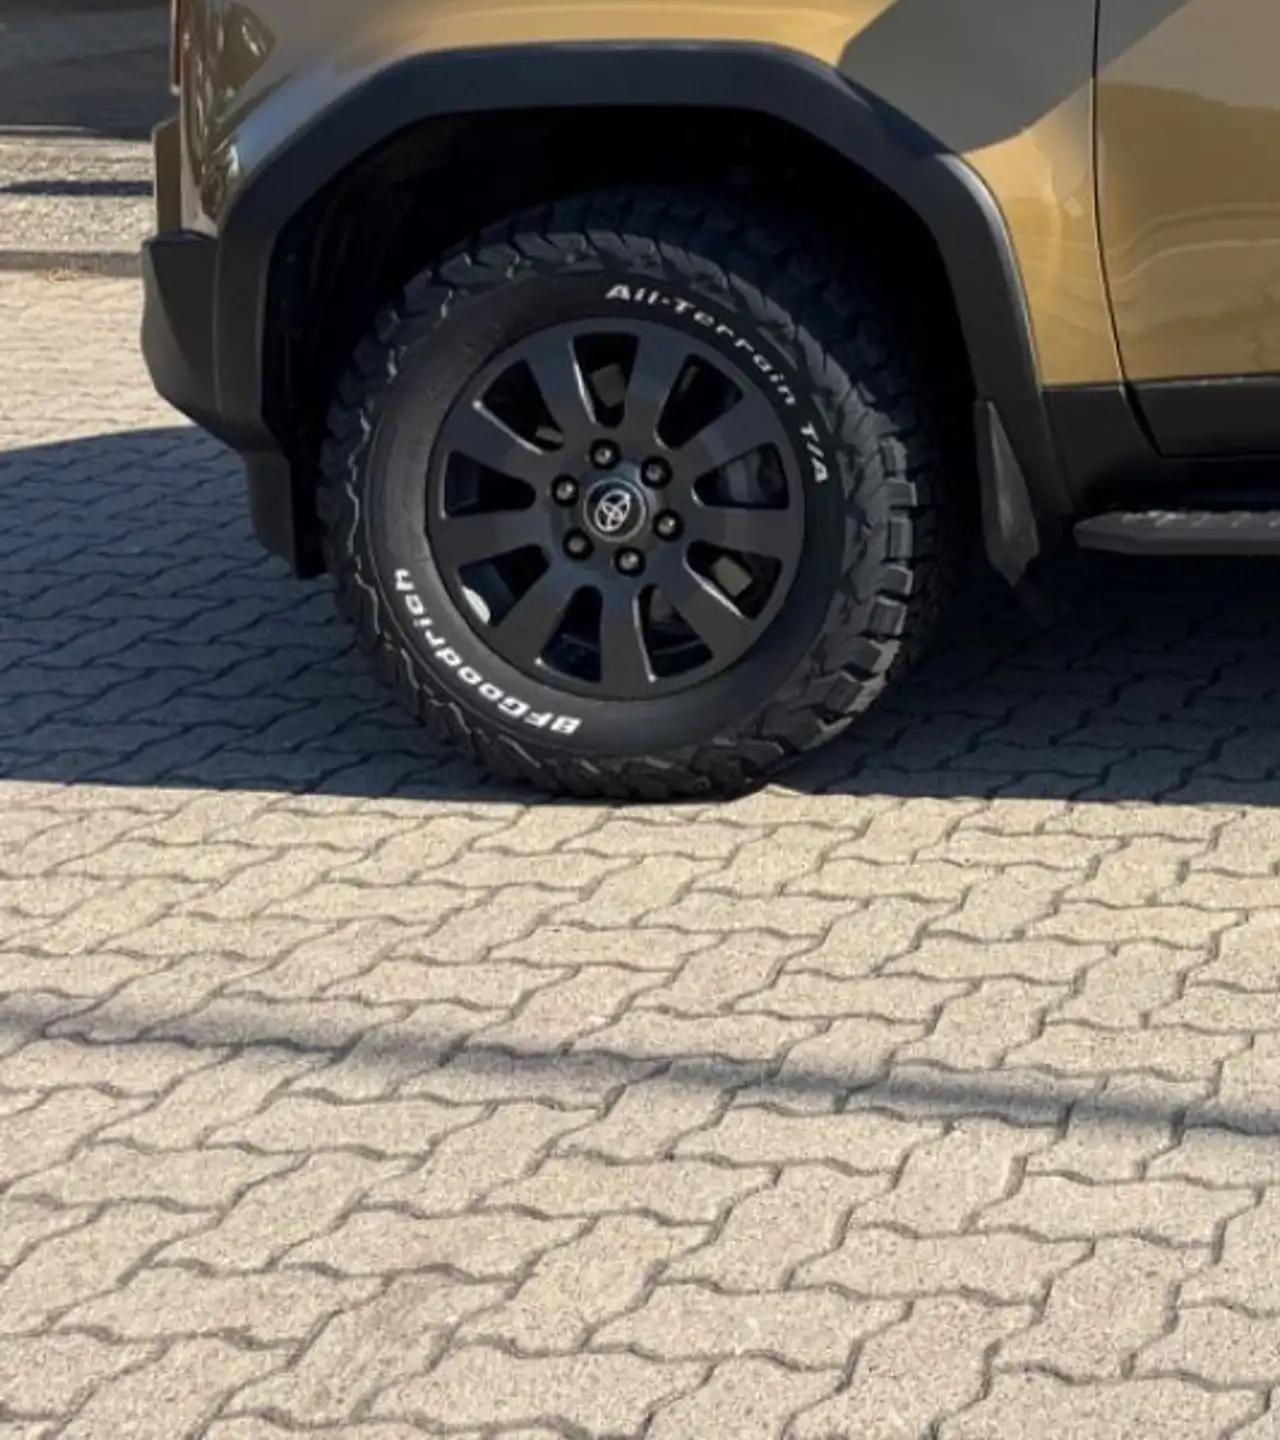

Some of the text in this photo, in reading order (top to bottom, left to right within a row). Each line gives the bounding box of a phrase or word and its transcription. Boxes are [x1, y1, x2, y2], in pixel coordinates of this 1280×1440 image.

[604, 283, 829, 483] All-Terrain T/A
[394, 568, 583, 737] BFGoodrich
